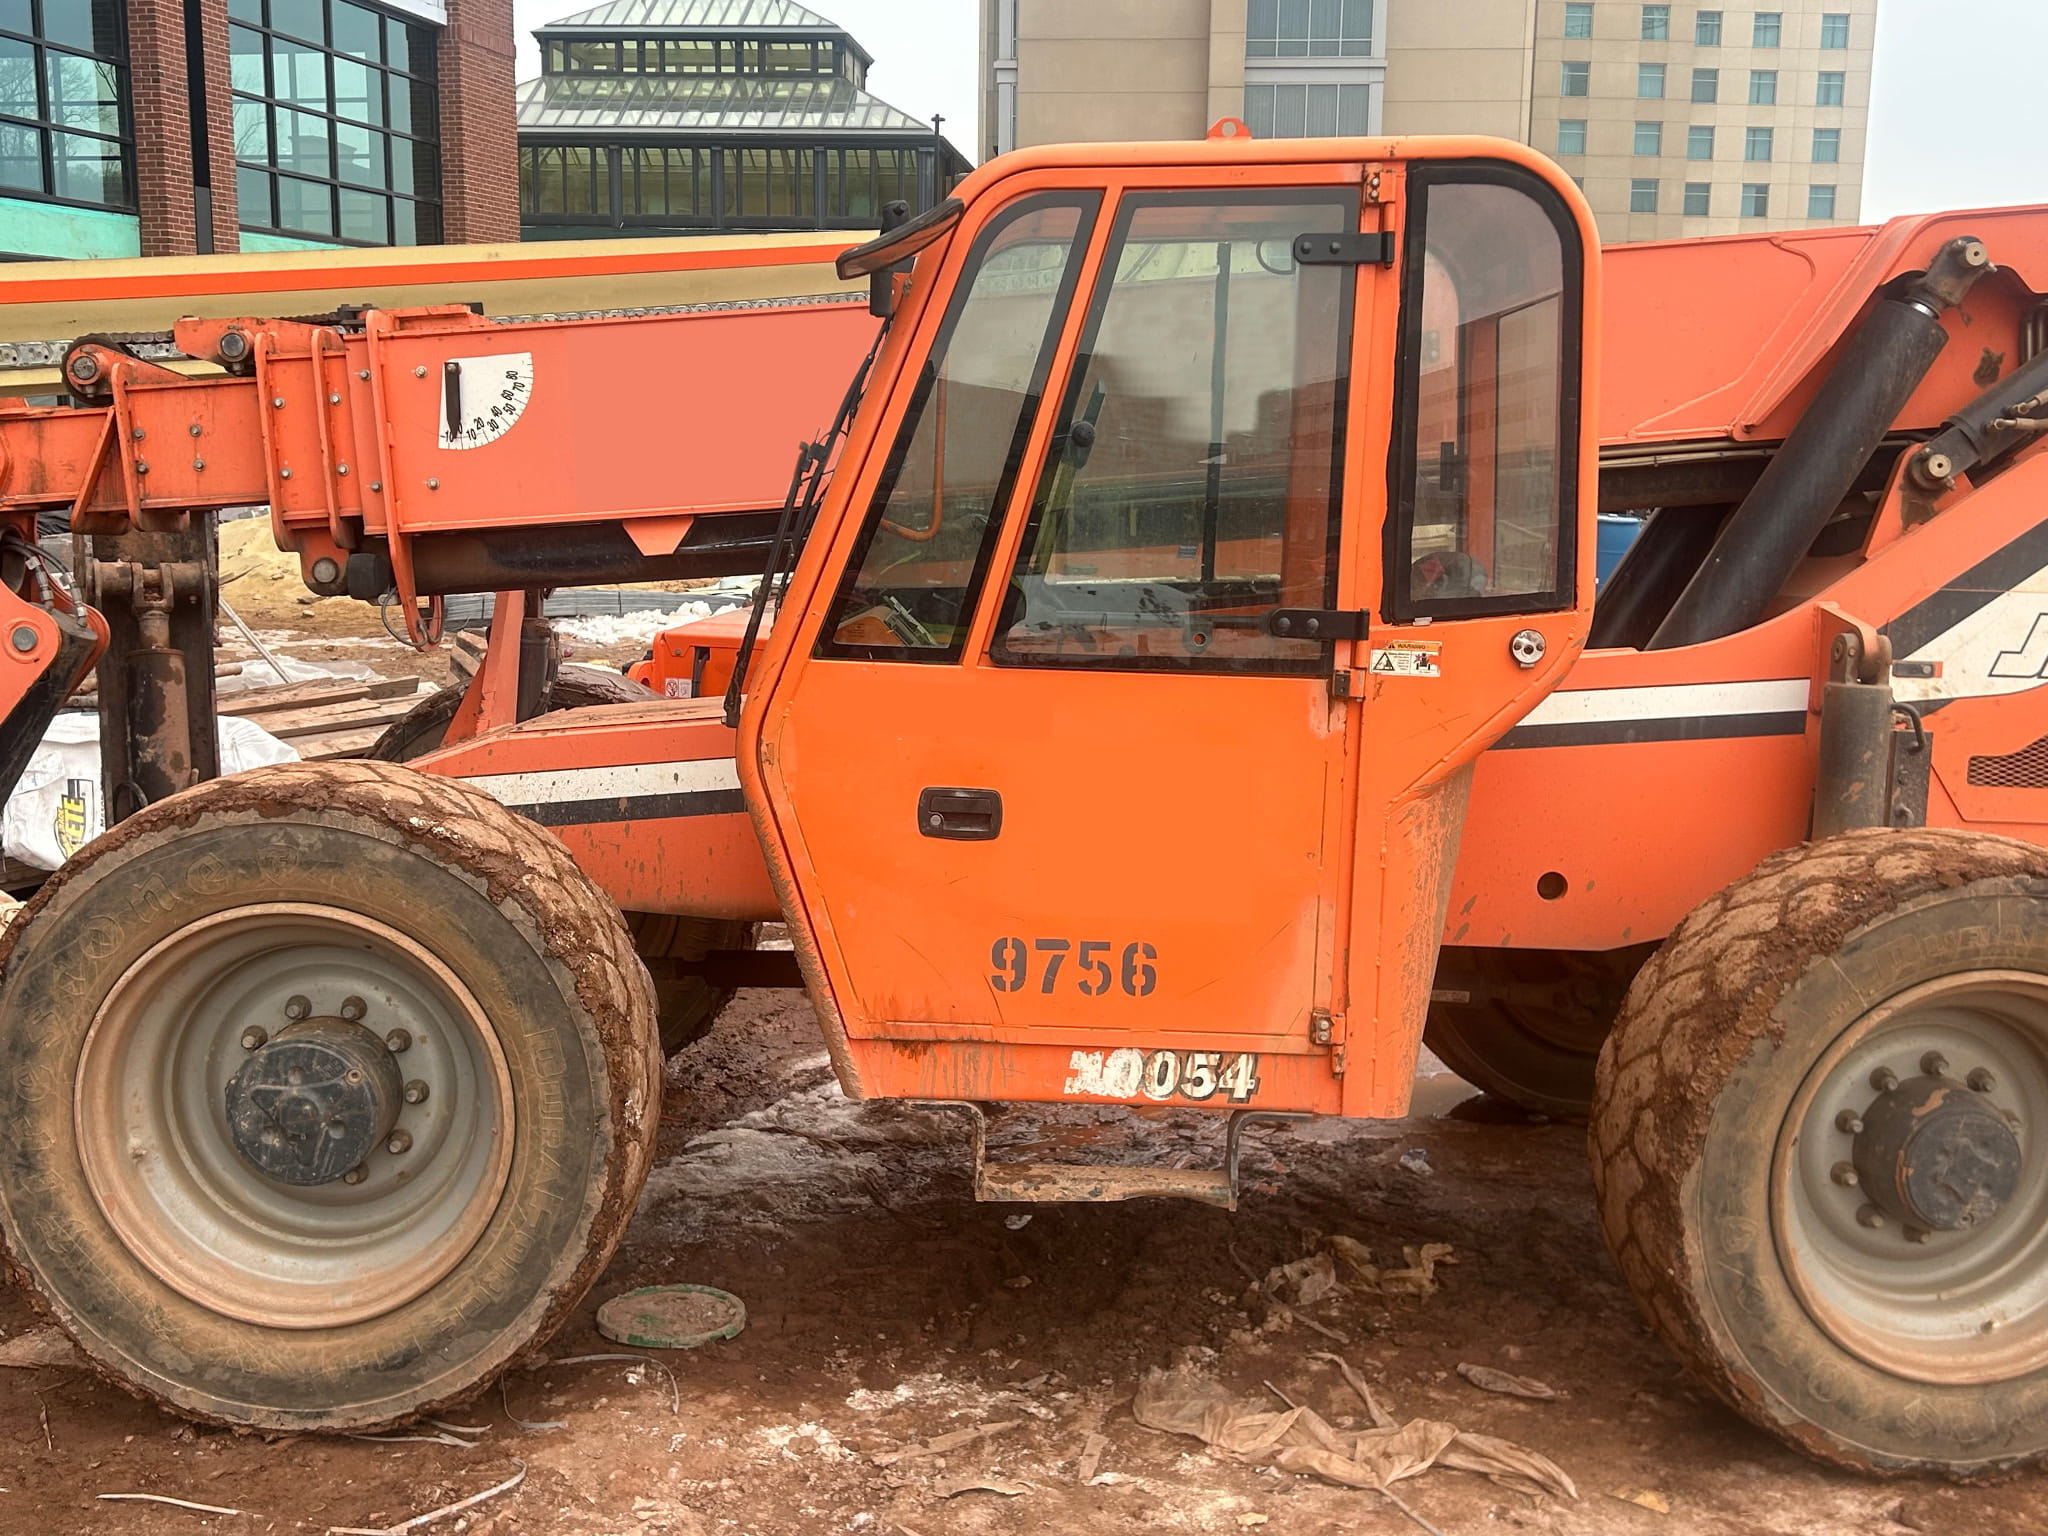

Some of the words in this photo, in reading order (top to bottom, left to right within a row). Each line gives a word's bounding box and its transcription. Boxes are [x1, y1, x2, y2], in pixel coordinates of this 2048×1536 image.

[506, 370, 518, 380] 80
[512, 382, 525, 392] 70
[501, 389, 514, 401] 60
[490, 406, 502, 417] 40
[502, 403, 516, 415] 50
[473, 417, 484, 430] 20
[487, 419, 499, 431] 30
[466, 428, 477, 441] 10
[991, 937, 1158, 997] 9756
